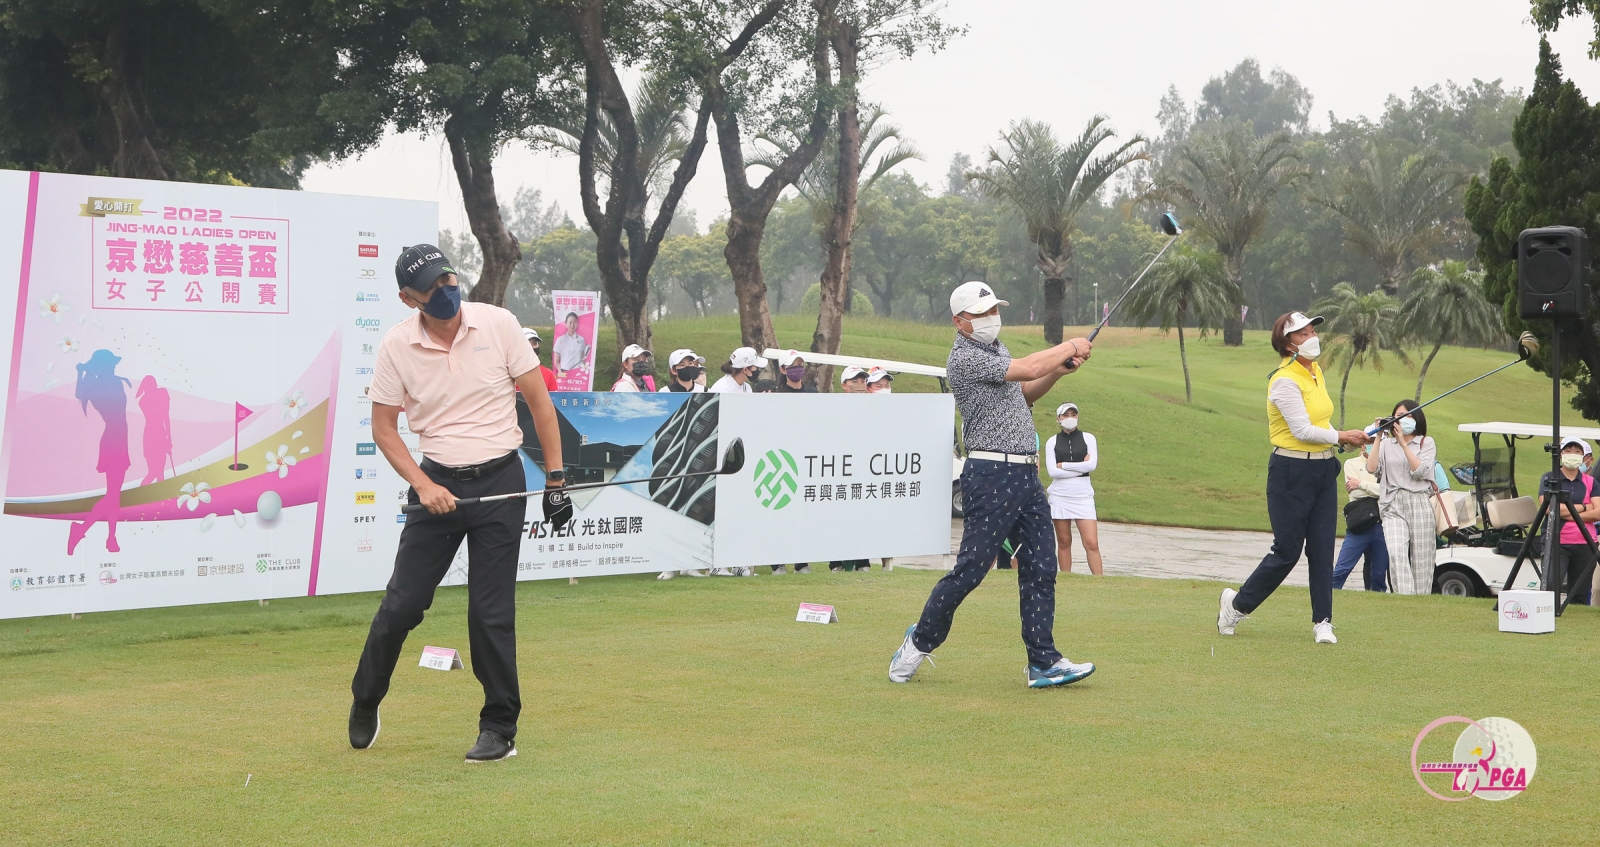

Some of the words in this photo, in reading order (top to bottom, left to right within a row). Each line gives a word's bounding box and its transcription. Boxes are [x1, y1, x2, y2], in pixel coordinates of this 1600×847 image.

[94, 200, 134, 213] 愛心開打
[163, 206, 222, 223] 2022
[106, 222, 177, 235] JING-MAO
[182, 227, 234, 238] LADIES
[239, 229, 277, 240] OPEN
[106, 238, 277, 278] 京懋慈善盃
[407, 258, 425, 273] THE
[106, 278, 277, 305] 女子公開賽
[355, 316, 380, 328] dyaco
[561, 398, 612, 407] 建築新美學
[804, 454, 852, 477] THE
[869, 452, 921, 476] CLUB
[803, 481, 921, 502] 再興高爾夫俱樂部
[581, 516, 643, 536] 光鈦國際
[577, 542, 594, 551] Build
[602, 541, 624, 550] Inspire
[119, 569, 185, 580] 台灣女子職業高爾夫協會
[209, 563, 245, 576] 京懋建設
[26, 573, 86, 586] 教育部體育署
